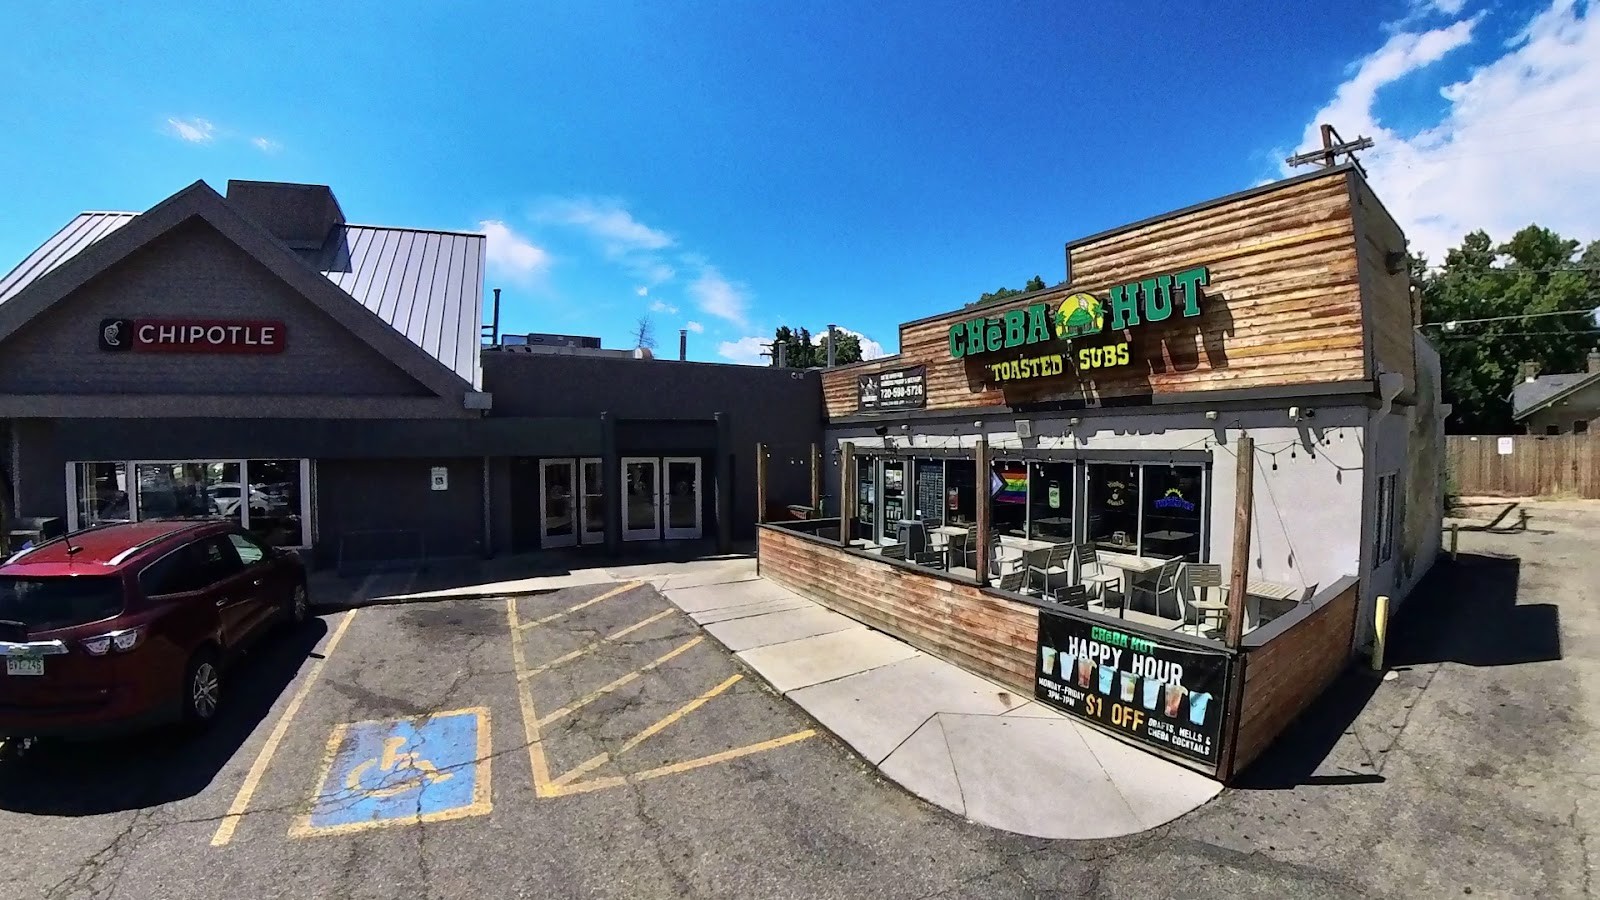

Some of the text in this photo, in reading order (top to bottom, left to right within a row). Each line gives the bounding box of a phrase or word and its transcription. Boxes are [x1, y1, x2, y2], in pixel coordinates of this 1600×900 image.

[1109, 267, 1209, 330] HUT
[138, 325, 275, 345] CHIPOTLE
[1079, 342, 1130, 370] SUBS
[1130, 636, 1158, 655] HUT
[1069, 635, 1183, 686] HAPPY HOUR
[1047, 689, 1075, 707] 3PM-7PM
[1085, 693, 1145, 731] $1 OFF
[1147, 727, 1210, 755] CHEBA COCKTAILS
[1205, 736, 1211, 745] &
